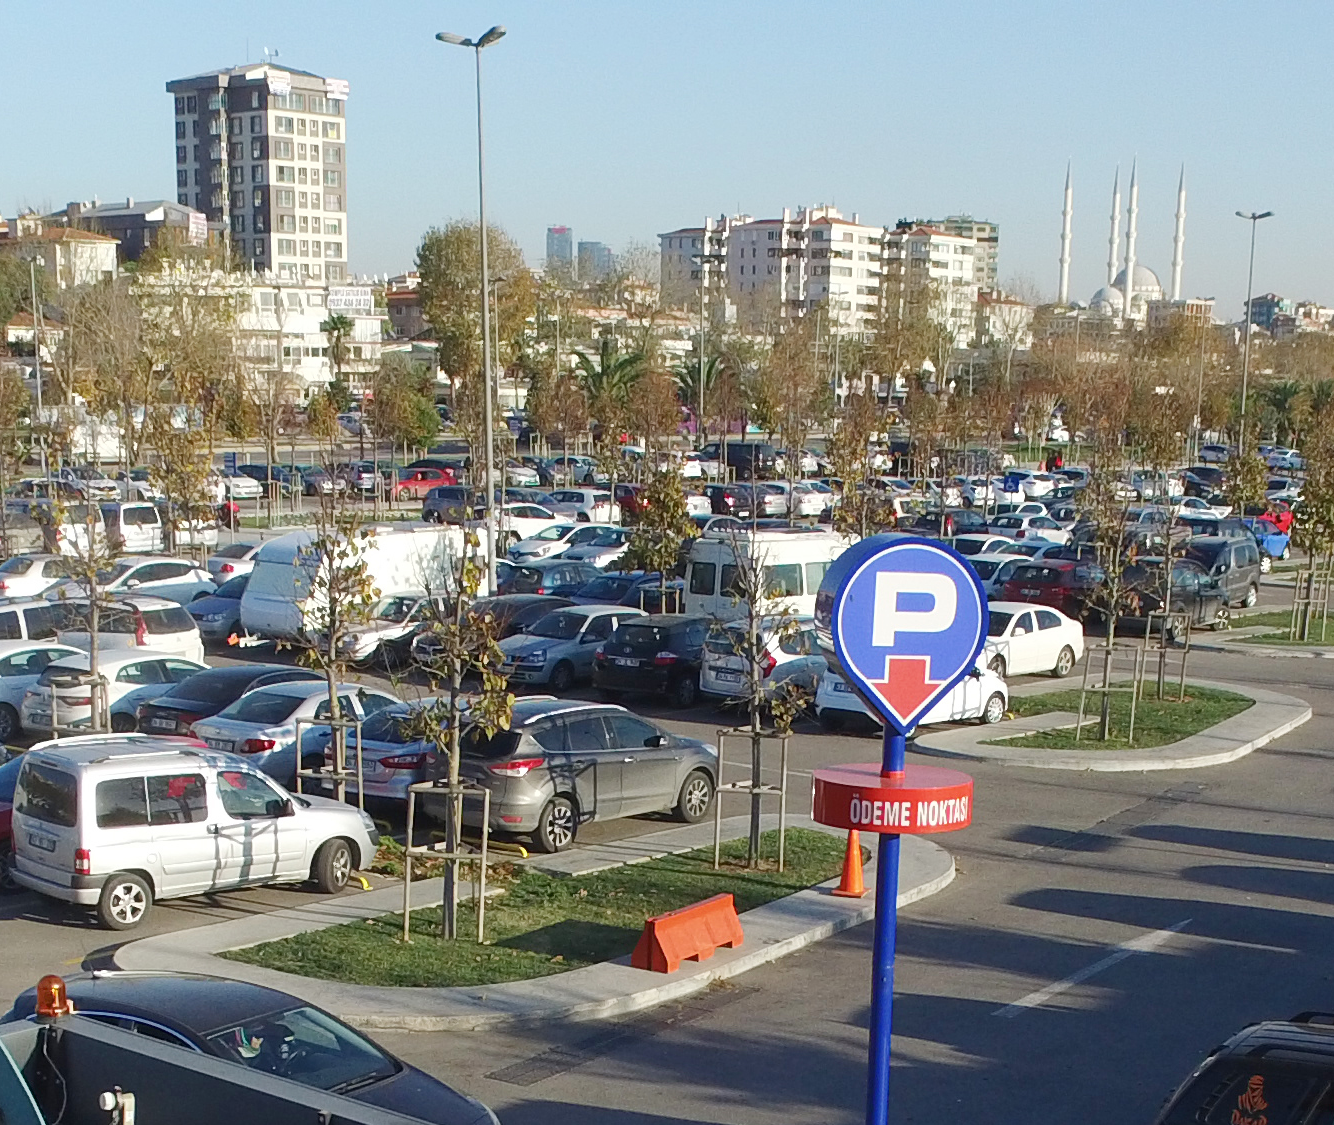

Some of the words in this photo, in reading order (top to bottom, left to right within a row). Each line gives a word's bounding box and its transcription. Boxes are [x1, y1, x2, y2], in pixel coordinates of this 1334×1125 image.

[872, 571, 958, 647] P
[850, 793, 911, 826] ÖDEME
[916, 796, 969, 827] NOKTASI
